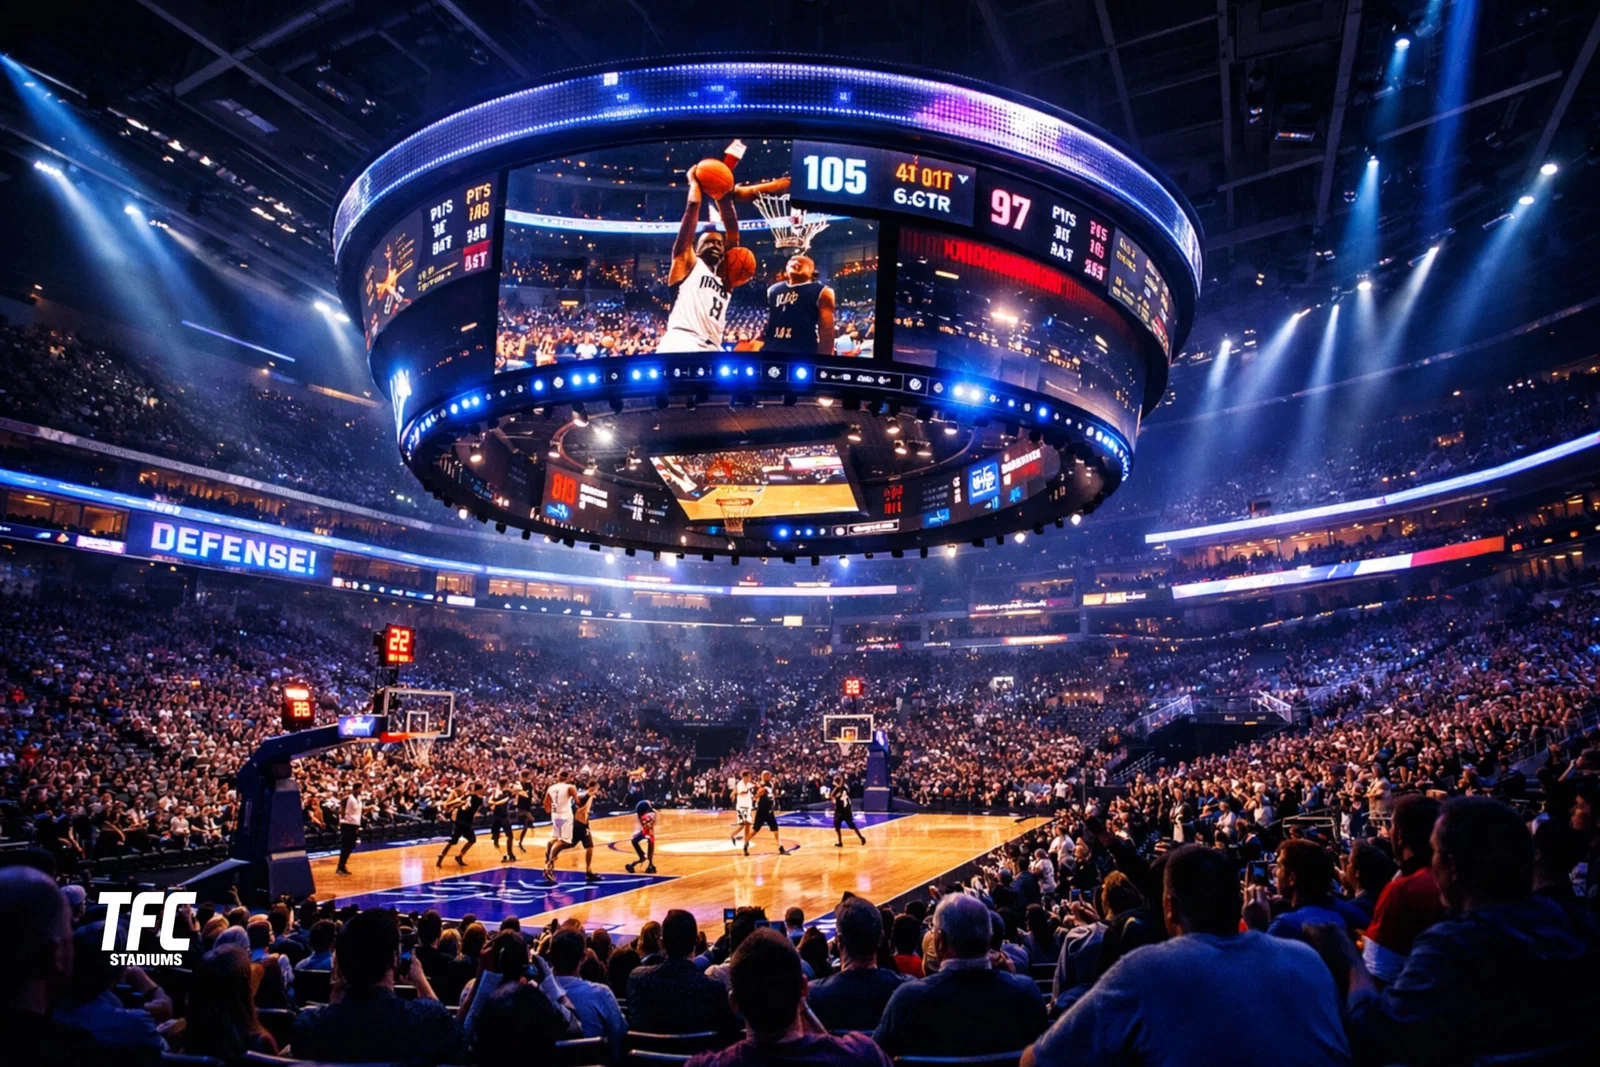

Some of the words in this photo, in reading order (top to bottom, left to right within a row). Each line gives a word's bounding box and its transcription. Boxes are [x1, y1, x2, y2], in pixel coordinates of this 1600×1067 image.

[803, 155, 867, 195] 105
[990, 188, 1031, 231] 97
[151, 521, 317, 576] DEFENSE!
[389, 628, 410, 652] 22
